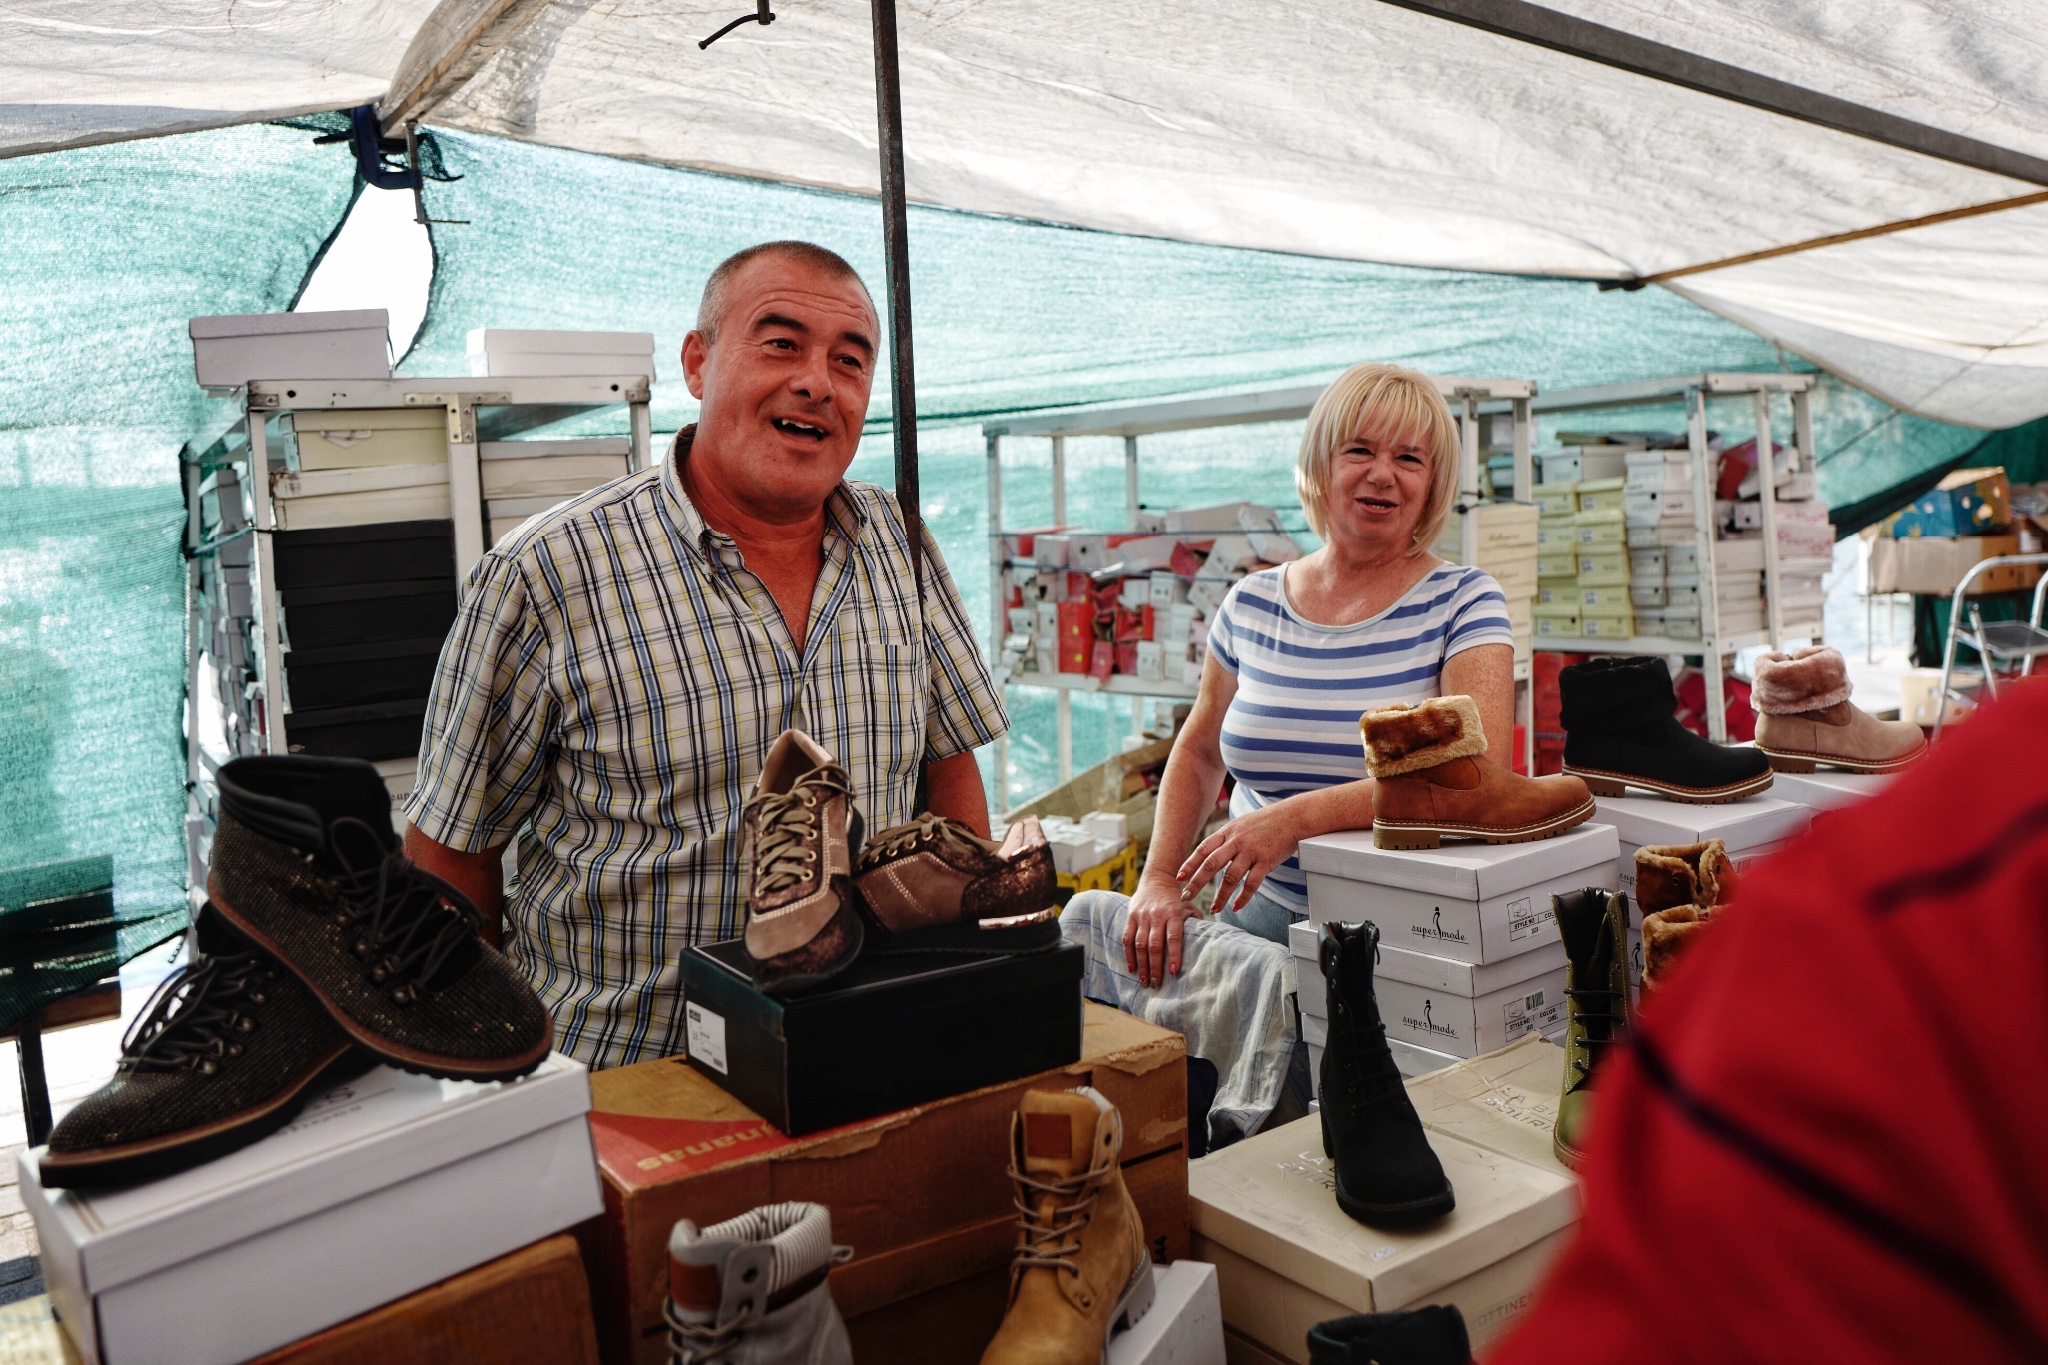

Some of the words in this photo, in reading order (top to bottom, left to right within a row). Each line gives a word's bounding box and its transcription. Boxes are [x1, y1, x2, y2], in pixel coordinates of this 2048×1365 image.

[1411, 924, 1438, 939] super
[1441, 929, 1467, 941] mode
[1514, 920, 1528, 930] STYLE
[1539, 1007, 1556, 1018] COLOR
[1402, 1016, 1429, 1031] super
[1432, 1023, 1457, 1036] mode
[1509, 1019, 1524, 1030] STYLE
[1501, 1087, 1527, 1104] LA
[1298, 1150, 1325, 1166] LA
